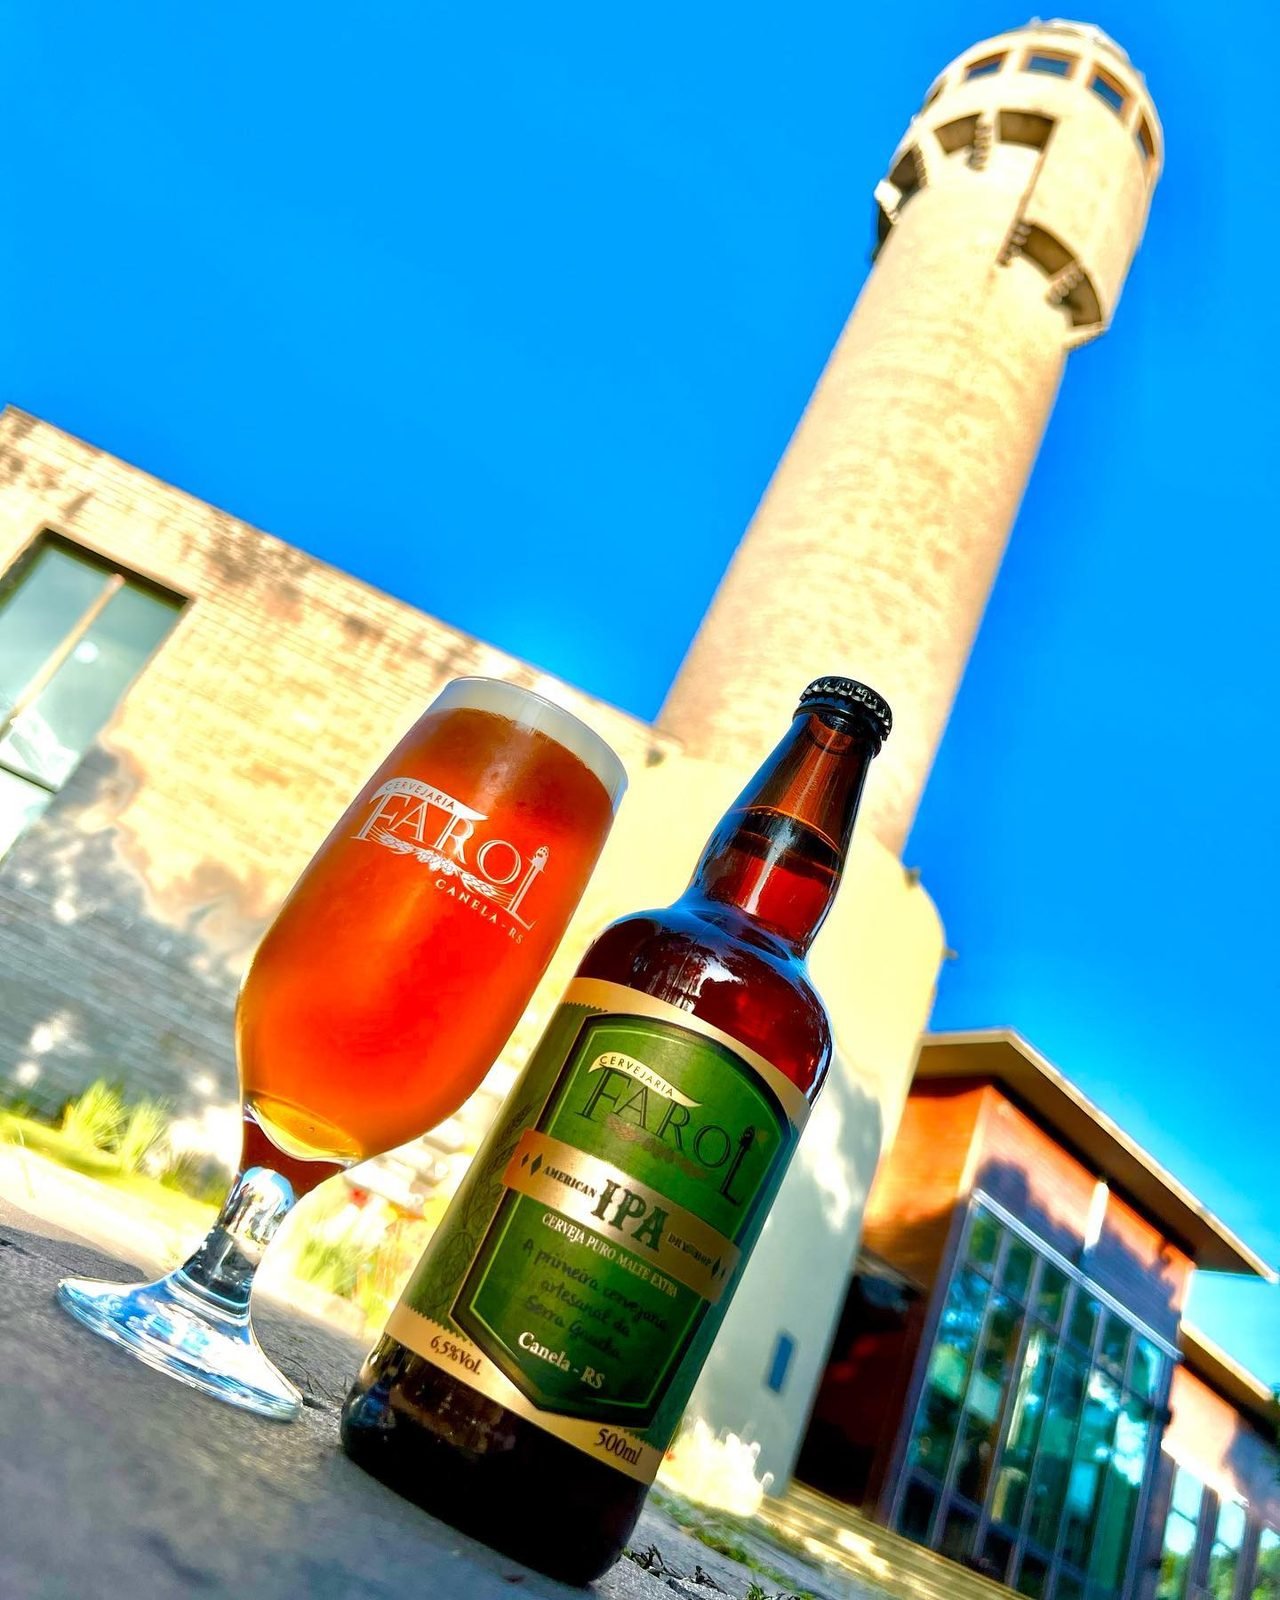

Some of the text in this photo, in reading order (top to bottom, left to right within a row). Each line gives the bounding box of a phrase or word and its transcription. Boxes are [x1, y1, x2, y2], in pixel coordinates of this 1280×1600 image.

[385, 780, 455, 811] CERVEJARIA
[349, 792, 550, 932] FAROL
[434, 877, 498, 924] CANELA
[508, 926, 525, 945] RS
[598, 1054, 675, 1098] CERVEJARIA
[573, 1064, 757, 1207] FAROL
[542, 1164, 599, 1200] AMERICAN
[590, 1177, 670, 1254] IPA
[522, 1237, 535, 1258] A
[533, 1248, 601, 1292] primeira
[541, 1211, 680, 1300] CERVEJA PURO MALTE EXTRA
[517, 1330, 571, 1374] Canela
[580, 1364, 606, 1390] RS
[594, 1427, 644, 1466] 500ml
